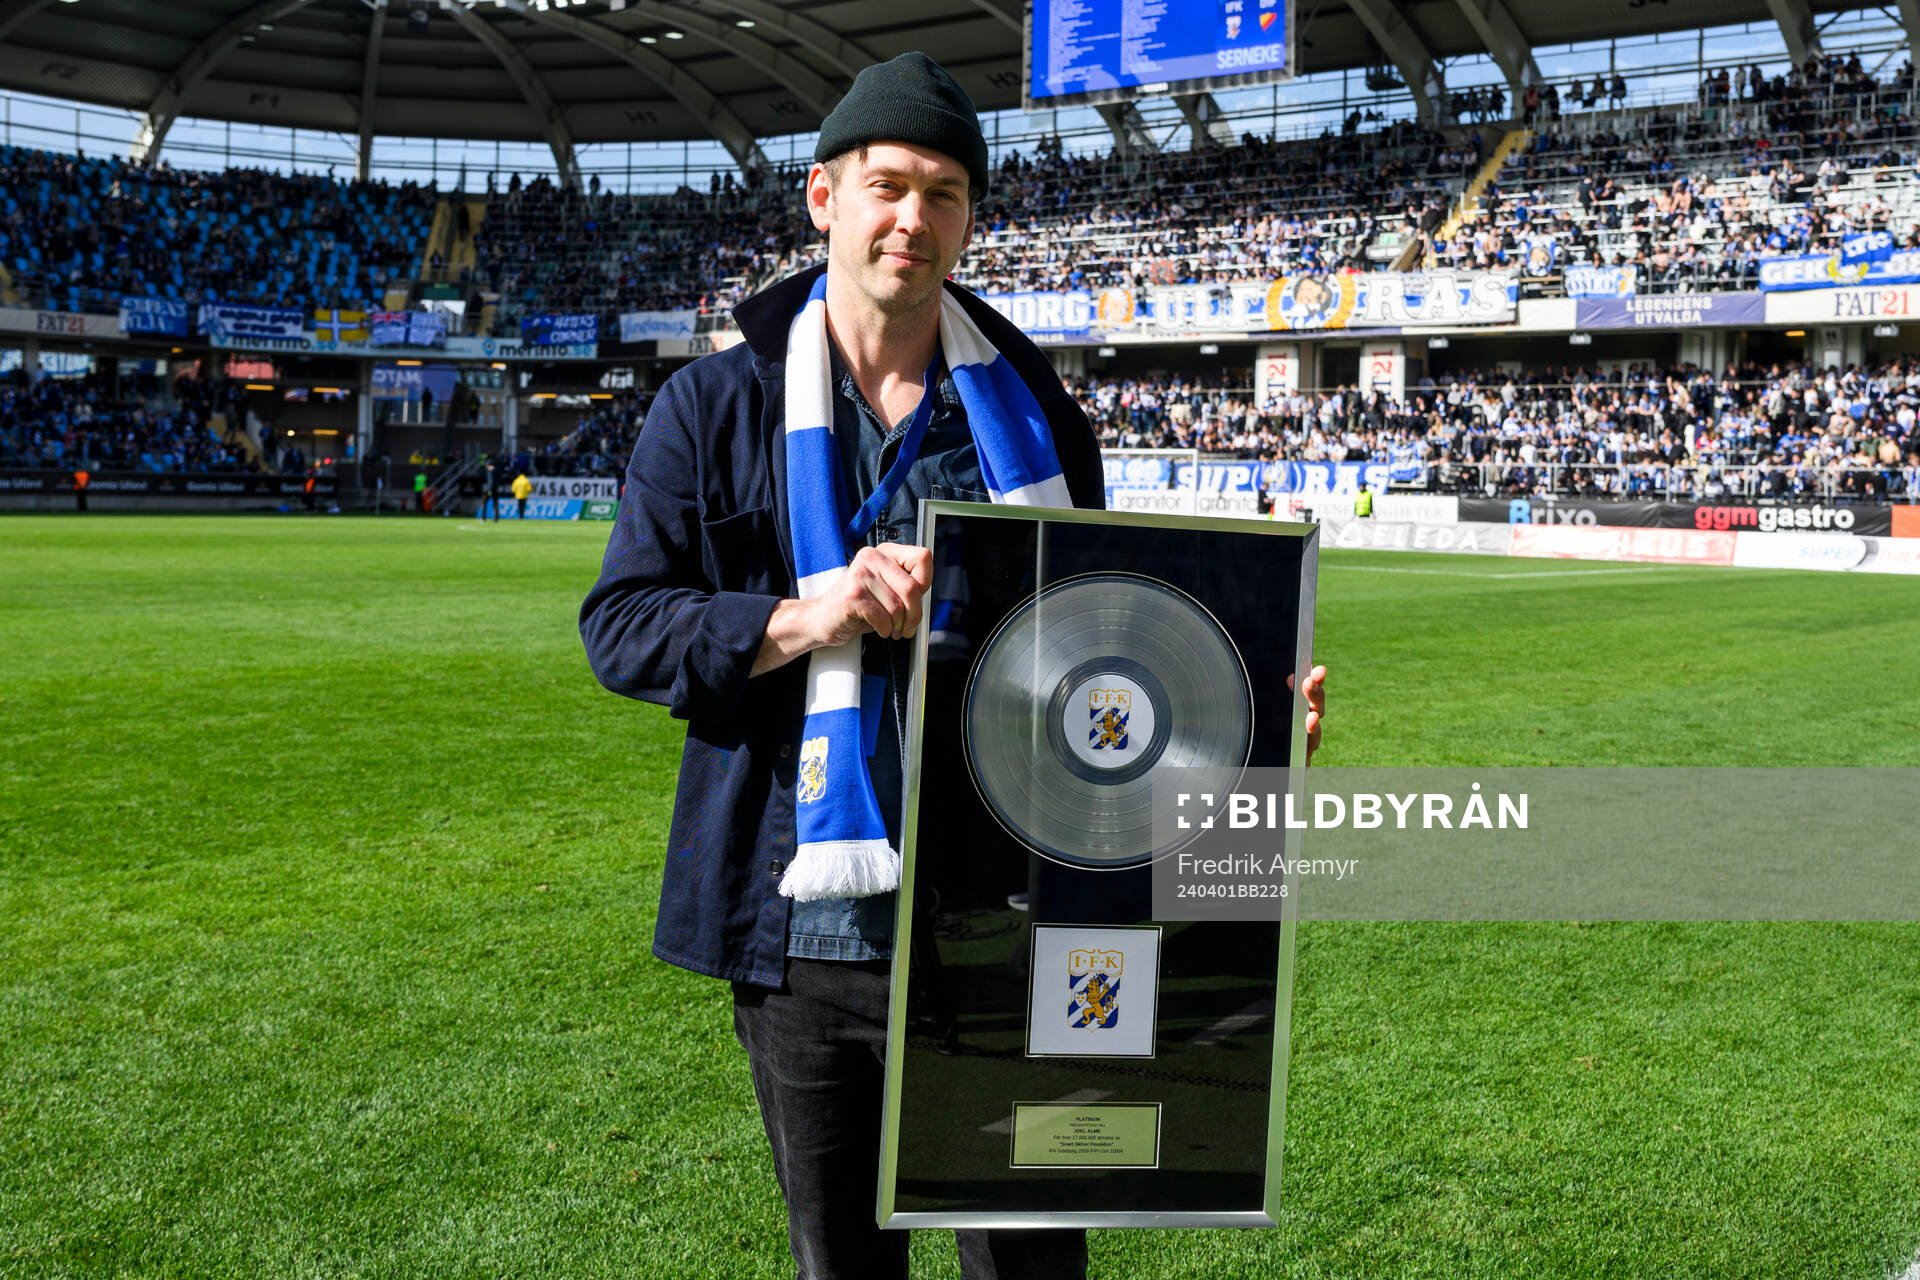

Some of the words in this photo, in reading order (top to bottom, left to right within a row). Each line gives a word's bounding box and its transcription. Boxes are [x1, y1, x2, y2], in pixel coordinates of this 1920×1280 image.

[1217, 43, 1281, 69] SERNEKE
[1625, 296, 1712, 312] LEGENDENS
[1834, 291, 1910, 317] FAT21
[37, 313, 85, 333] FAT21
[1634, 311, 1702, 325] UTVALDA
[571, 482, 614, 497] OPTIK
[1199, 494, 1258, 512] granito
[1509, 499, 1598, 525] Brixo
